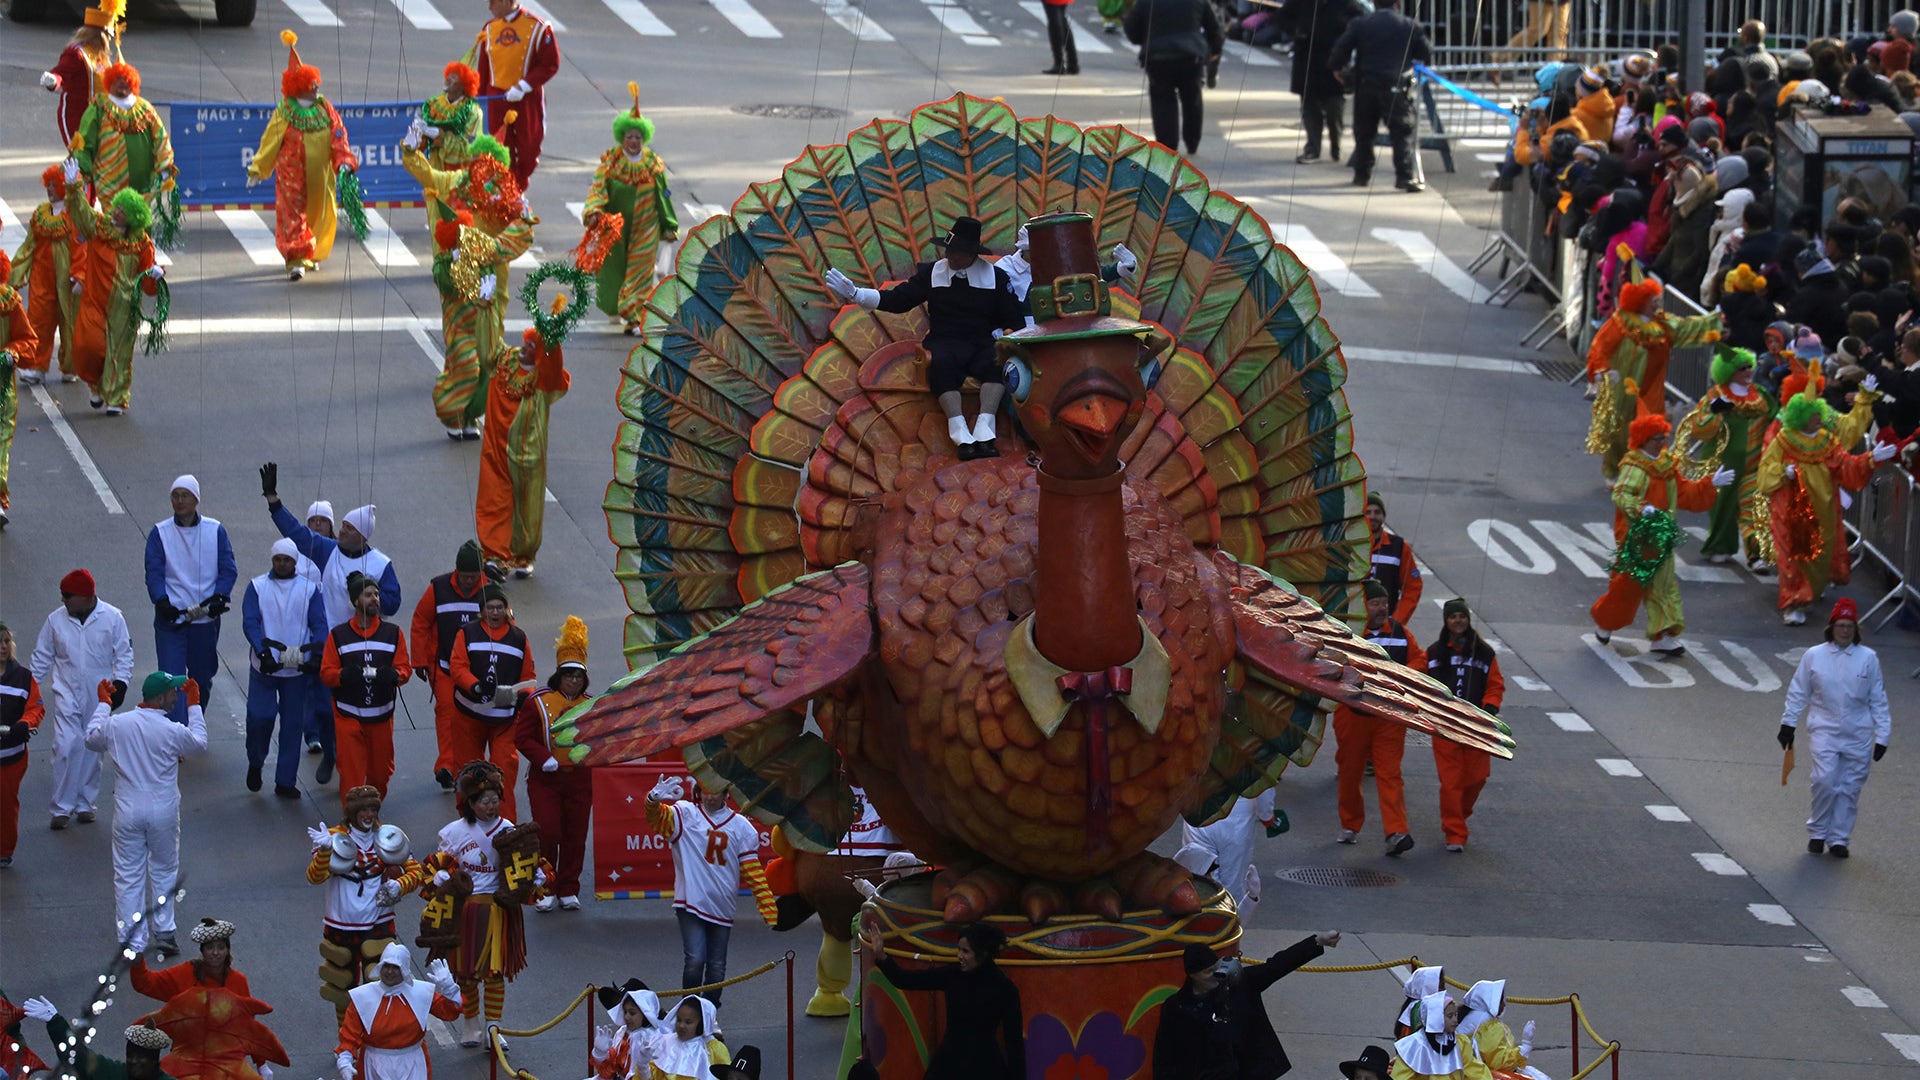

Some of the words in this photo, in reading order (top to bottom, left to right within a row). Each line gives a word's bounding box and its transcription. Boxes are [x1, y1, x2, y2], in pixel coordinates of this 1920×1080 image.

[197, 108, 251, 121] MACY'S
[372, 107, 398, 119] DAY
[1847, 140, 1889, 154] TITAN
[626, 833, 673, 850] MAC
[705, 829, 730, 867] R
